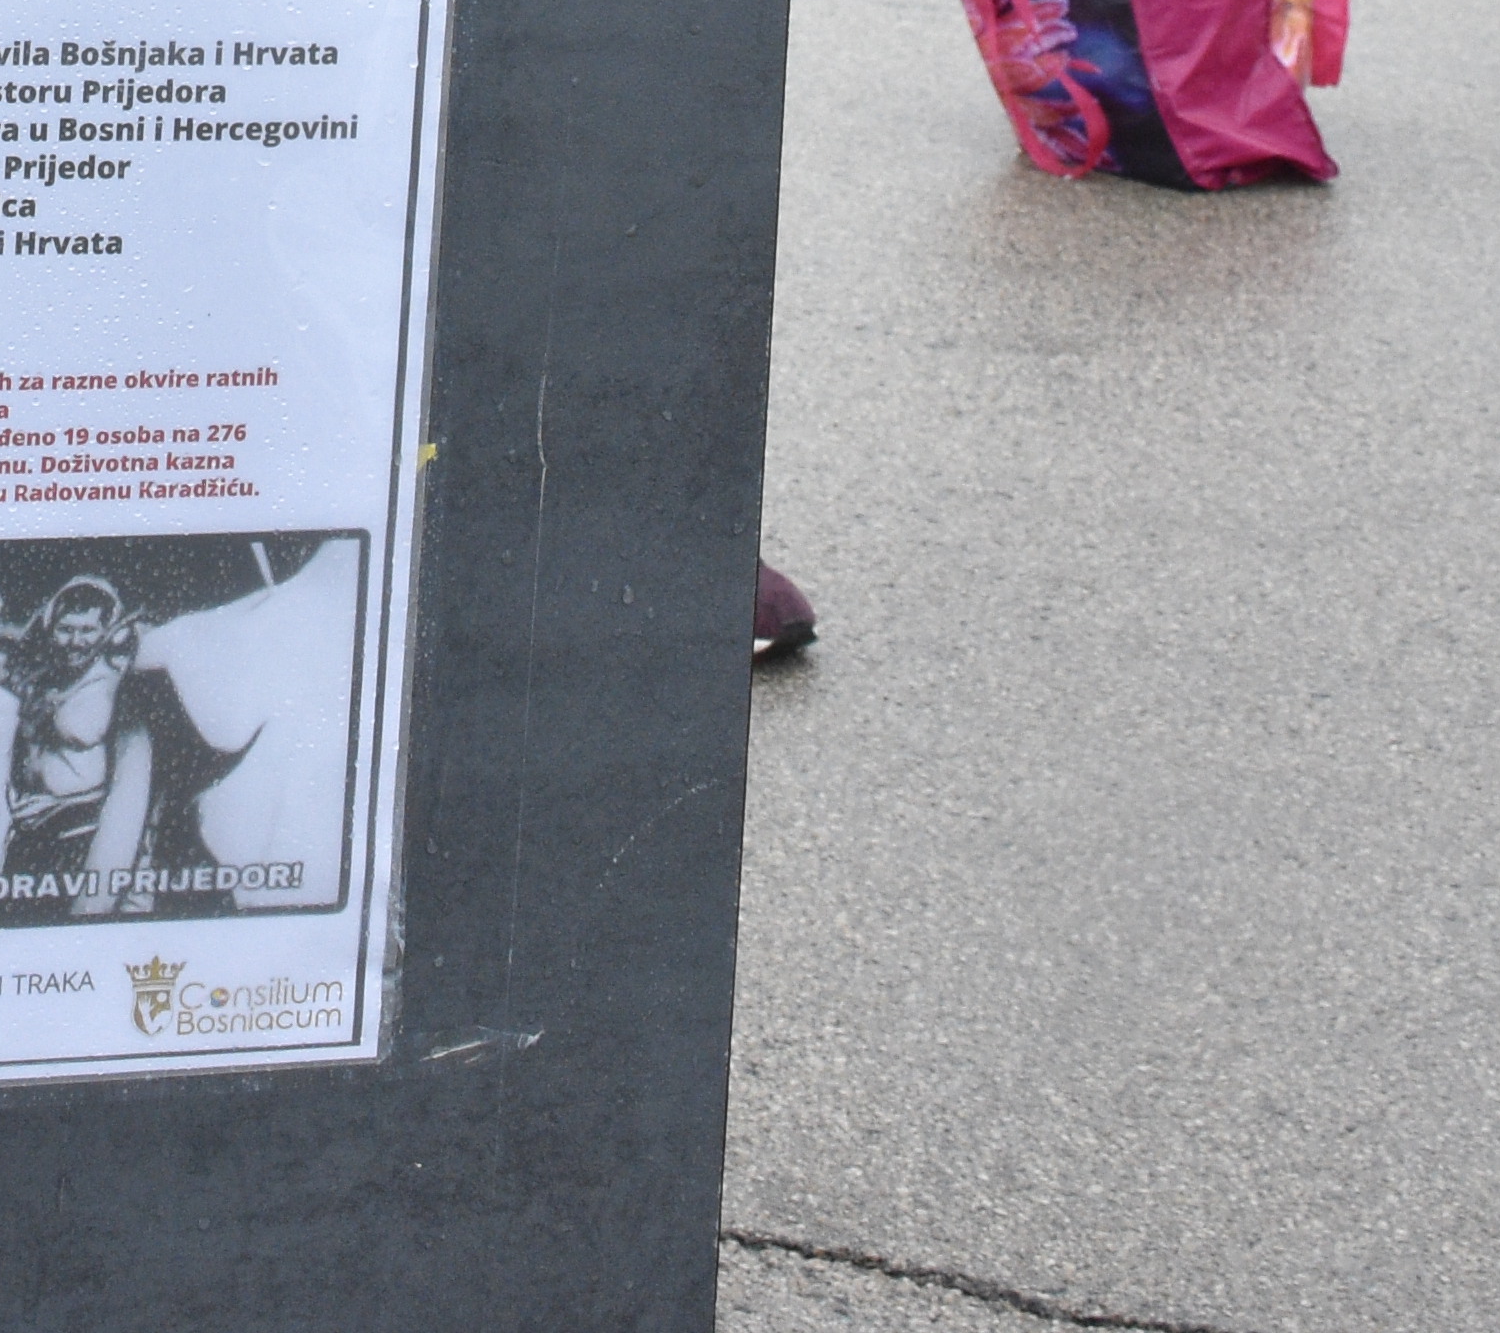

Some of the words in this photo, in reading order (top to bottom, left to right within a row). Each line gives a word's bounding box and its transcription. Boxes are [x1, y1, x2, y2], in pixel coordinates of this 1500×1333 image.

[60, 40, 205, 73] Bošnjaka
[215, 40, 223, 66] i
[233, 41, 338, 66] Hrvata
[82, 78, 226, 111] Prijedora
[29, 122, 48, 142] u
[58, 115, 145, 142] Bosni
[154, 115, 163, 142] i
[172, 114, 358, 148] Hercegovini
[4, 153, 132, 188] Prijedor
[14, 231, 123, 256] Hrvata
[18, 376, 44, 391] za
[51, 374, 118, 391] razne
[124, 368, 200, 389] okvire
[206, 366, 278, 388] ratnih
[63, 427, 90, 446] 19
[95, 425, 165, 445] osoba
[172, 428, 201, 443] na
[206, 423, 247, 442] 276
[40, 453, 159, 474] Doživotna
[165, 451, 235, 471] kazna
[14, 482, 132, 503] Radovanu
[138, 478, 260, 499] Karadžiću.
[108, 862, 305, 895] PRIJEDOR!
[11, 970, 95, 996] TRAKA
[178, 977, 345, 1011] Consilium
[176, 1006, 343, 1036] Bosniacum
